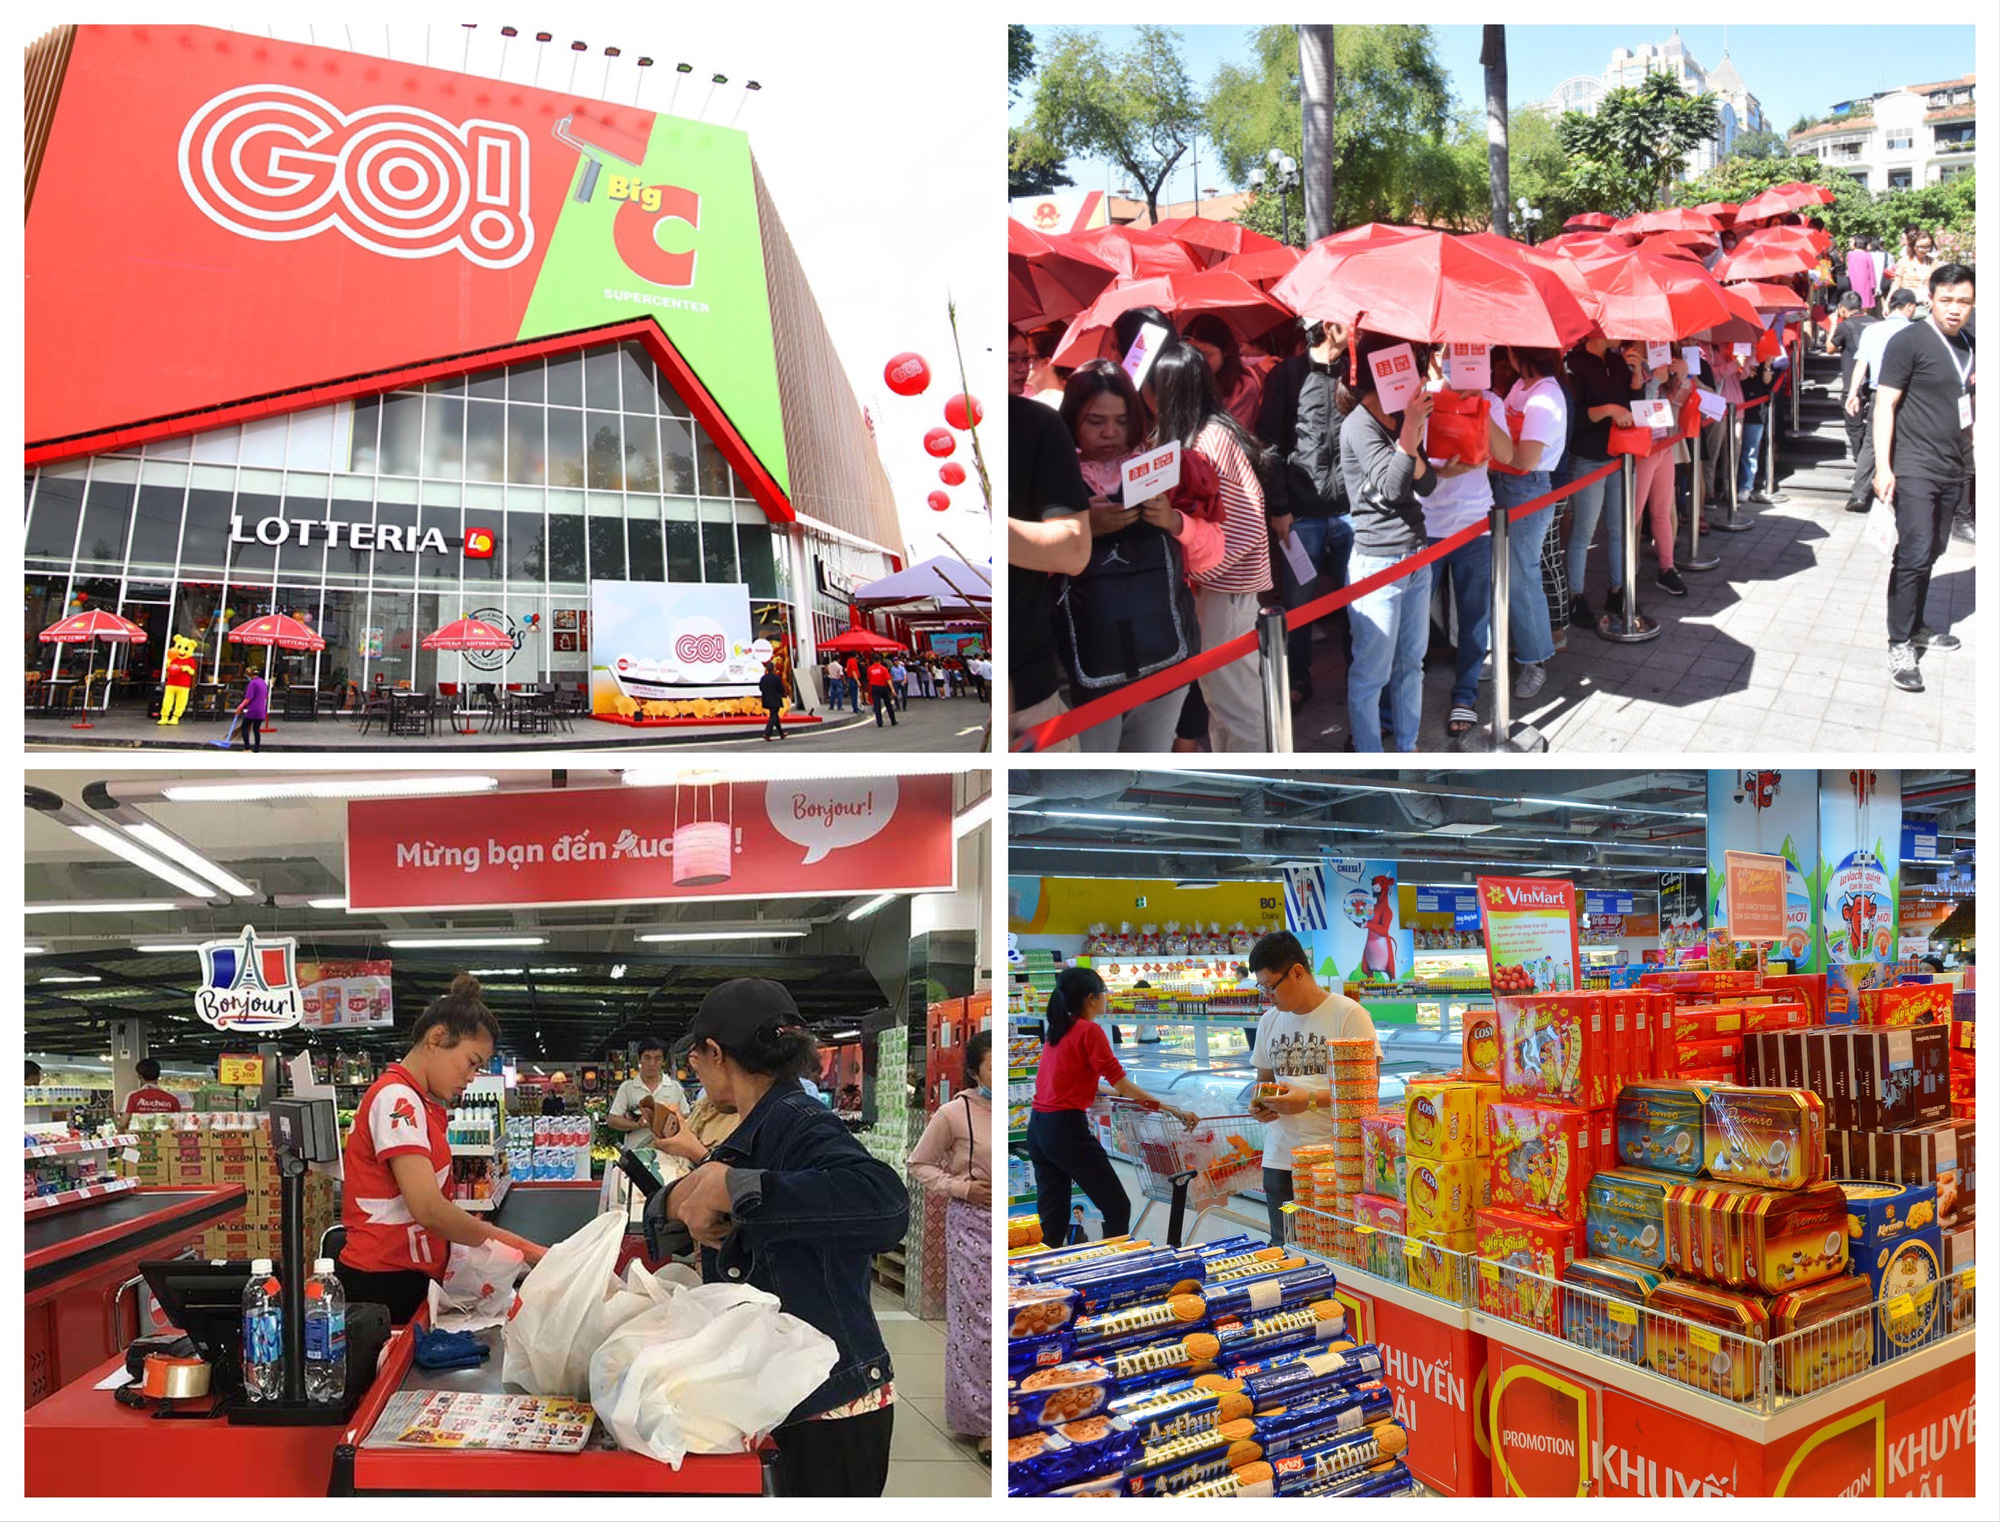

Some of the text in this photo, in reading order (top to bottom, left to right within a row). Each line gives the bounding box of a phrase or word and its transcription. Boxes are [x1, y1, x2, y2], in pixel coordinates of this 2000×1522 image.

[178, 84, 535, 269] GO!
[608, 174, 664, 213] Big
[613, 185, 702, 289] C
[604, 288, 709, 313] SUPERCENTER
[232, 515, 449, 554] LOTTERIA
[675, 634, 726, 664] GO!
[792, 791, 873, 828] Bonjour!
[396, 840, 480, 873] Mừng
[488, 838, 544, 871] bạn
[551, 828, 607, 862] đến
[1337, 862, 1362, 873] CHEESE!
[1505, 885, 1566, 905] VinMart
[1858, 976, 1876, 989] NESTEA
[198, 989, 297, 1024] Bonjour!
[1473, 1026, 1494, 1039] COSY
[1449, 1111, 1458, 1140] COSY
[1635, 1101, 1679, 1120] Premio
[1727, 1106, 1773, 1127] Premio
[1451, 1185, 1460, 1212] COSY
[1606, 1191, 1647, 1212] Premio
[1786, 1210, 1829, 1228] Premio
[1103, 1302, 1175, 1336] Arthur
[1252, 1308, 1318, 1338] Arthur
[1116, 1342, 1190, 1378] Arthur
[1150, 1408, 1222, 1444] Arthur
[1145, 1428, 1225, 1467] Arthur
[1503, 1430, 1575, 1457] PROMOTION
[1276, 1456, 1303, 1474] Arluy
[1313, 1438, 1380, 1480] Arthur
